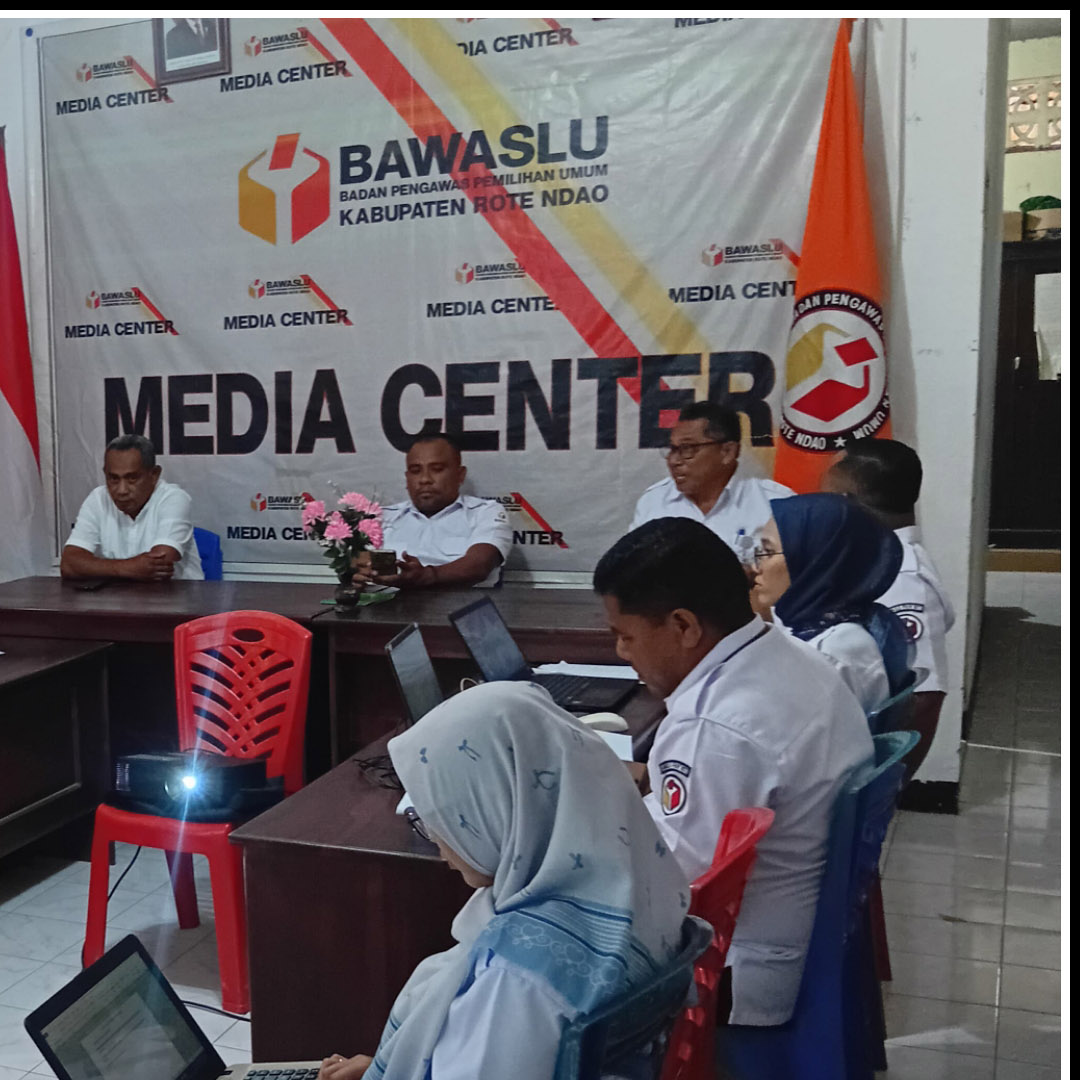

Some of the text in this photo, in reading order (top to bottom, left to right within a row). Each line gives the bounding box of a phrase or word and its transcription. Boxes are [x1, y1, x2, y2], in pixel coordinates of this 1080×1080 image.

[493, 28, 573, 53] CENTER
[220, 60, 348, 92] MEDIA CENTER
[56, 87, 169, 115] MEDIA CENTER
[339, 115, 609, 185] BAWASLU
[340, 164, 609, 202] BADAN PENGAWAS PEMILIHAN UMUM
[340, 184, 609, 227] KABUPATEN ROTE NDAO
[668, 280, 797, 303] MEDIA CENT
[224, 309, 348, 330] MEDIA CENTER
[427, 296, 555, 318] MEDIA CENTE
[65, 320, 174, 338] MEDIA CENTER
[103, 350, 776, 456] MEDIA CENTER
[227, 526, 277, 540] MEDIA
[512, 530, 564, 545] NTER
